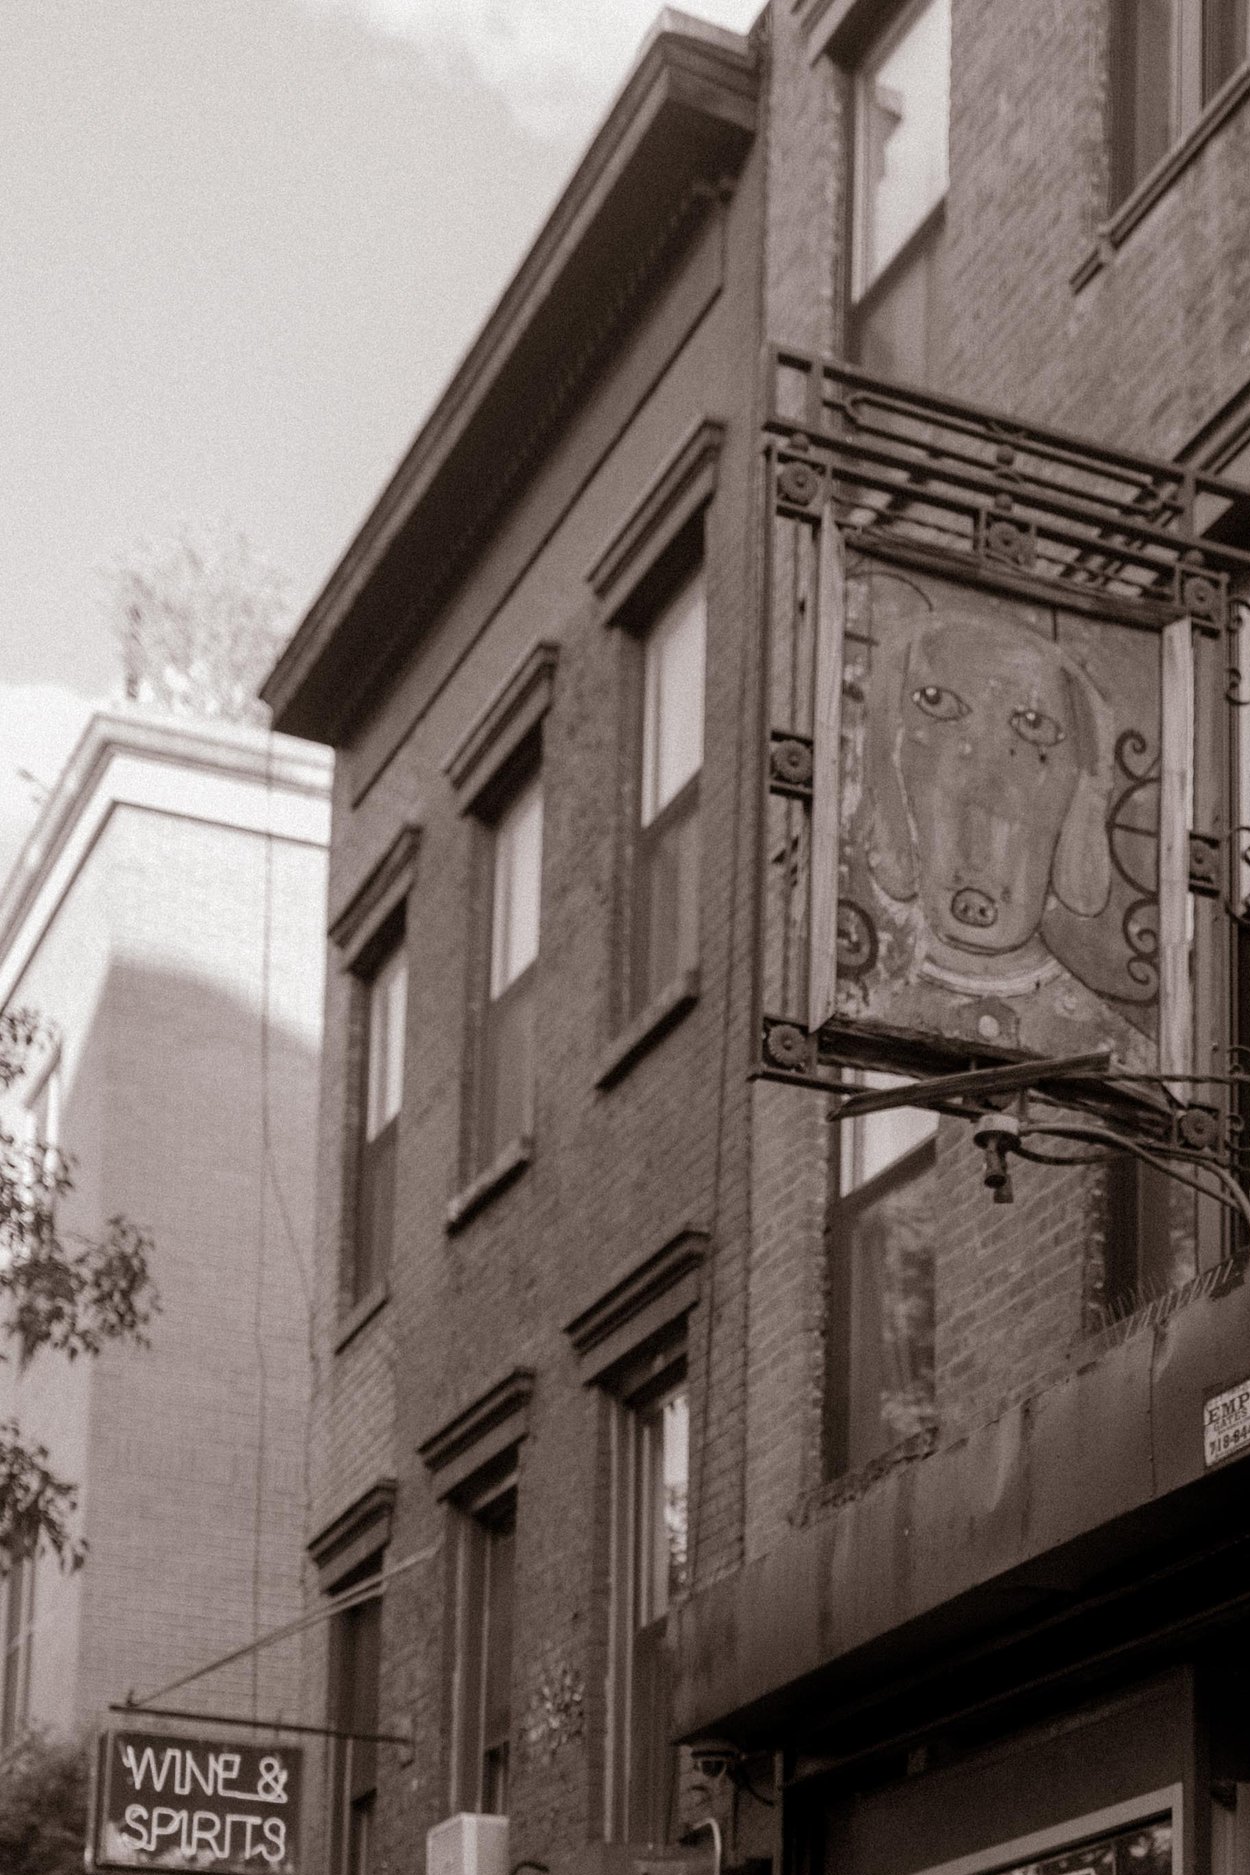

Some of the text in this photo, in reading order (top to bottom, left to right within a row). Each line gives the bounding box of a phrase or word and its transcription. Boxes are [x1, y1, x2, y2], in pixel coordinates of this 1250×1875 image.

[1214, 1407, 1247, 1431] GATES
[122, 1743, 289, 1804] WINE &
[122, 1803, 287, 1862] SPIRITS
